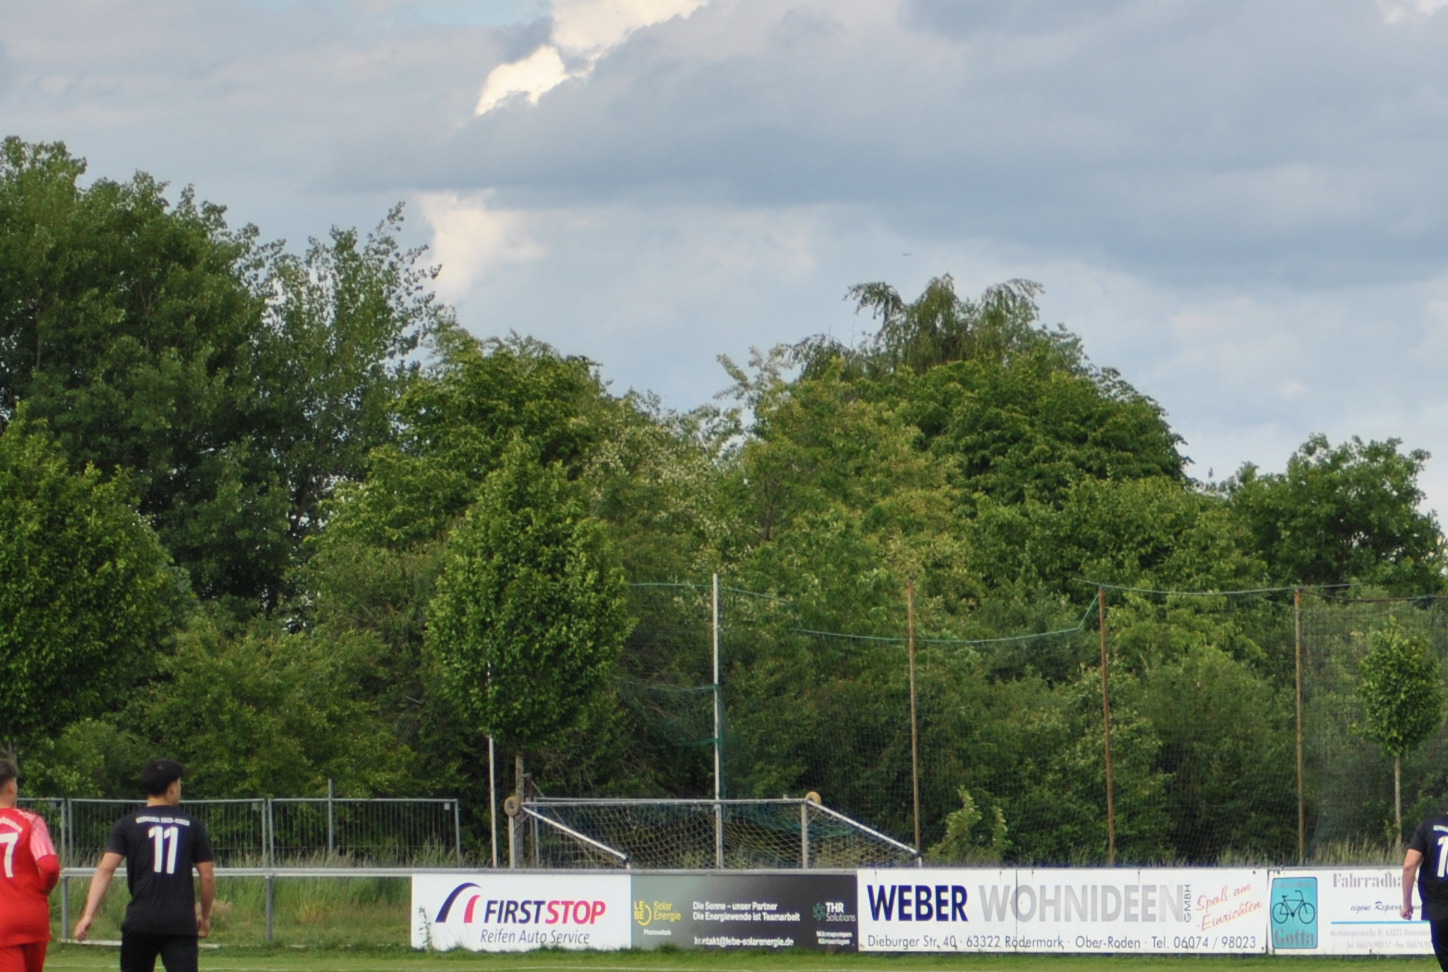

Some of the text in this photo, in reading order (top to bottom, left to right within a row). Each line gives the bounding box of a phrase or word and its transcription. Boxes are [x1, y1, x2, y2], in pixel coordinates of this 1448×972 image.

[0, 832, 18, 877] 7
[149, 826, 179, 874] 11
[1333, 872, 1401, 888] Fahrradha
[653, 901, 672, 910] Solar
[693, 901, 704, 910] Die
[705, 901, 726, 910] Sonne
[732, 902, 751, 910] unser
[752, 901, 778, 910] Partner
[867, 885, 968, 922] WEBER
[979, 885, 1184, 923] WOHNIDEEN
[1196, 886, 1228, 911] Spaß
[825, 902, 844, 913] THR
[1350, 904, 1371, 915] eigene
[653, 911, 681, 922] Energie
[693, 912, 800, 922] Die Energiewende ist Teamarbeit
[825, 913, 856, 922] Solutions
[1201, 900, 1262, 931] Einrichten
[480, 929, 590, 944] Reifen Auto Service
[868, 934, 919, 950] Dieburger
[923, 934, 939, 948] Str.
[943, 935, 956, 947] 40
[966, 935, 1000, 947] 63322
[1005, 934, 1063, 948] Rödermark
[1075, 936, 1141, 948] Ober-Roden
[1152, 936, 1169, 948] Tel.
[1173, 936, 1208, 949] 06074
[1221, 936, 1256, 948] 98023
